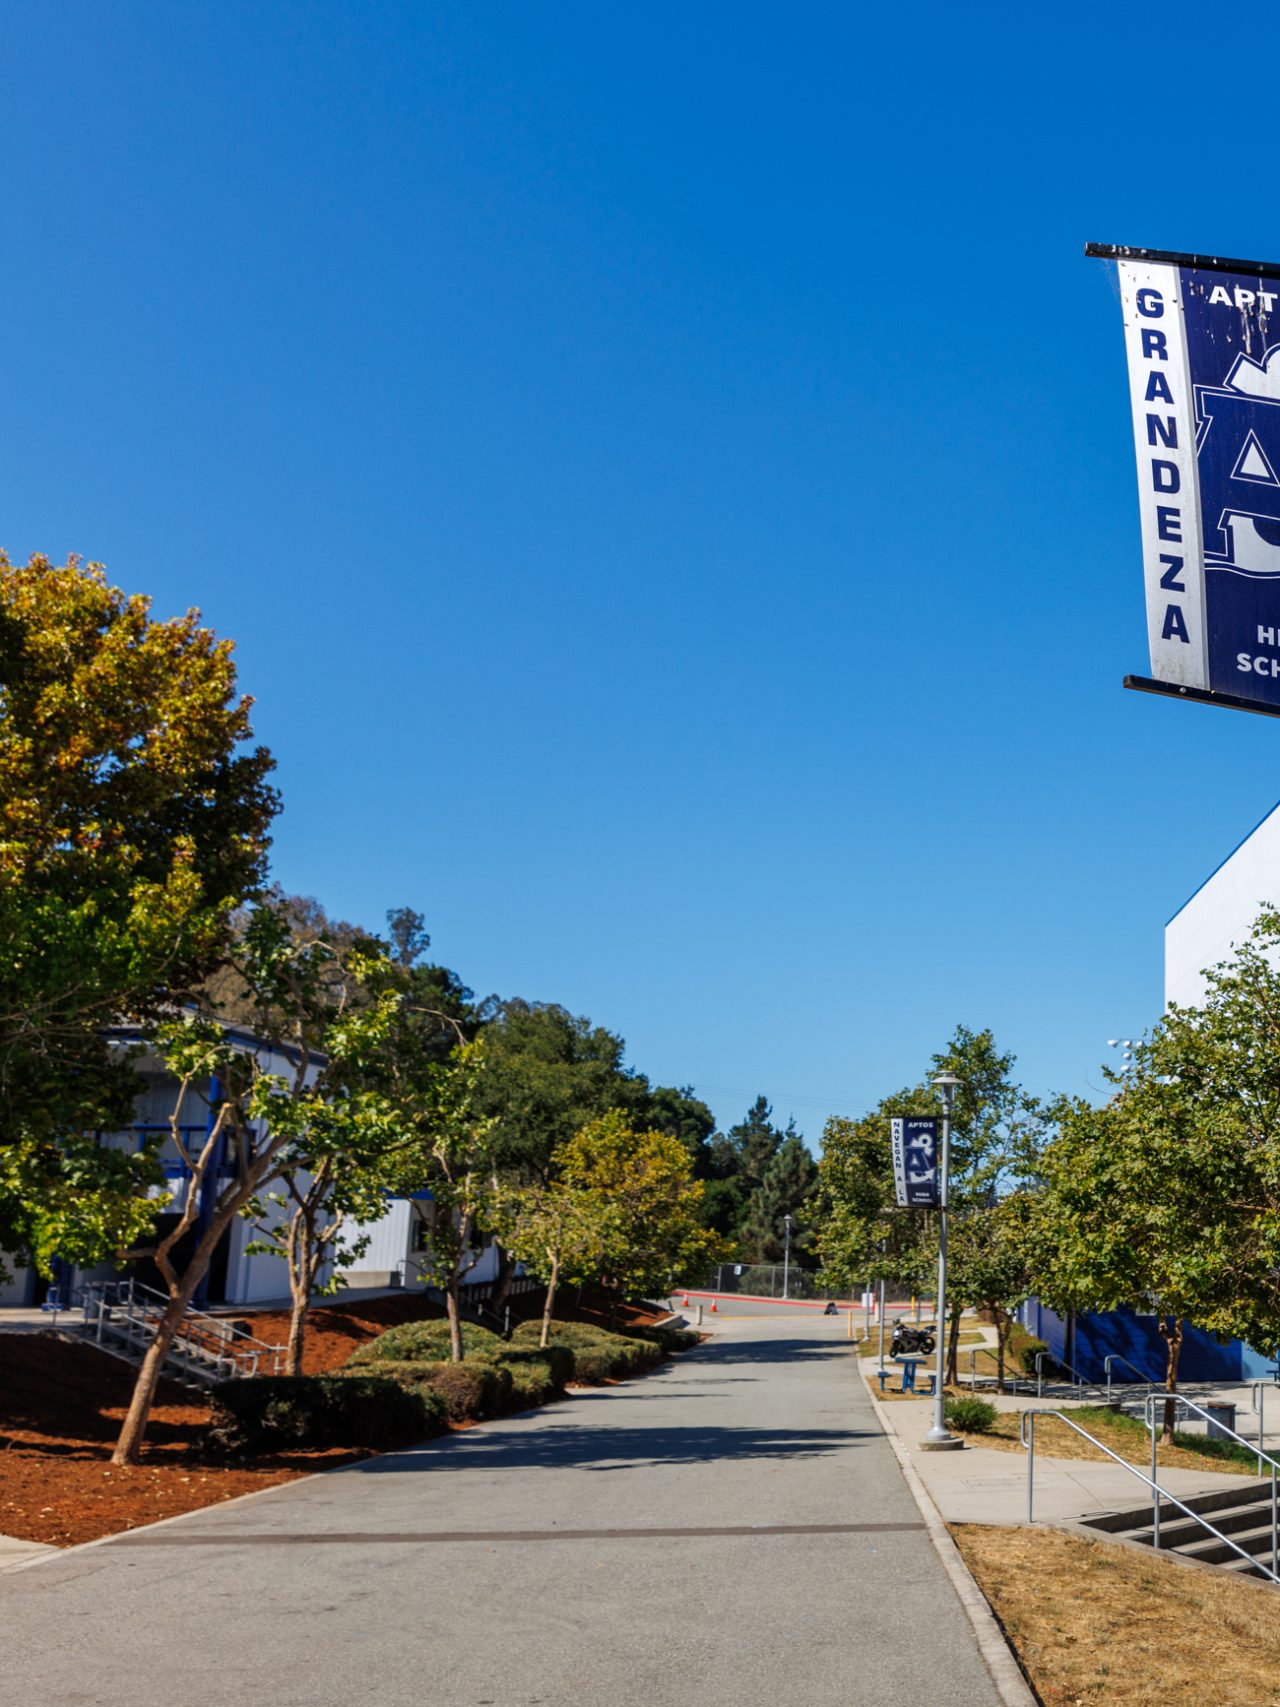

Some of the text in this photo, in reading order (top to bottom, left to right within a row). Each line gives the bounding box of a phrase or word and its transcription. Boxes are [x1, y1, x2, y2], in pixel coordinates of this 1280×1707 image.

[1136, 288, 1190, 644] GRANDEZA
[893, 1121, 902, 1169] NAVEGAN
[898, 1190, 905, 1202] LA
